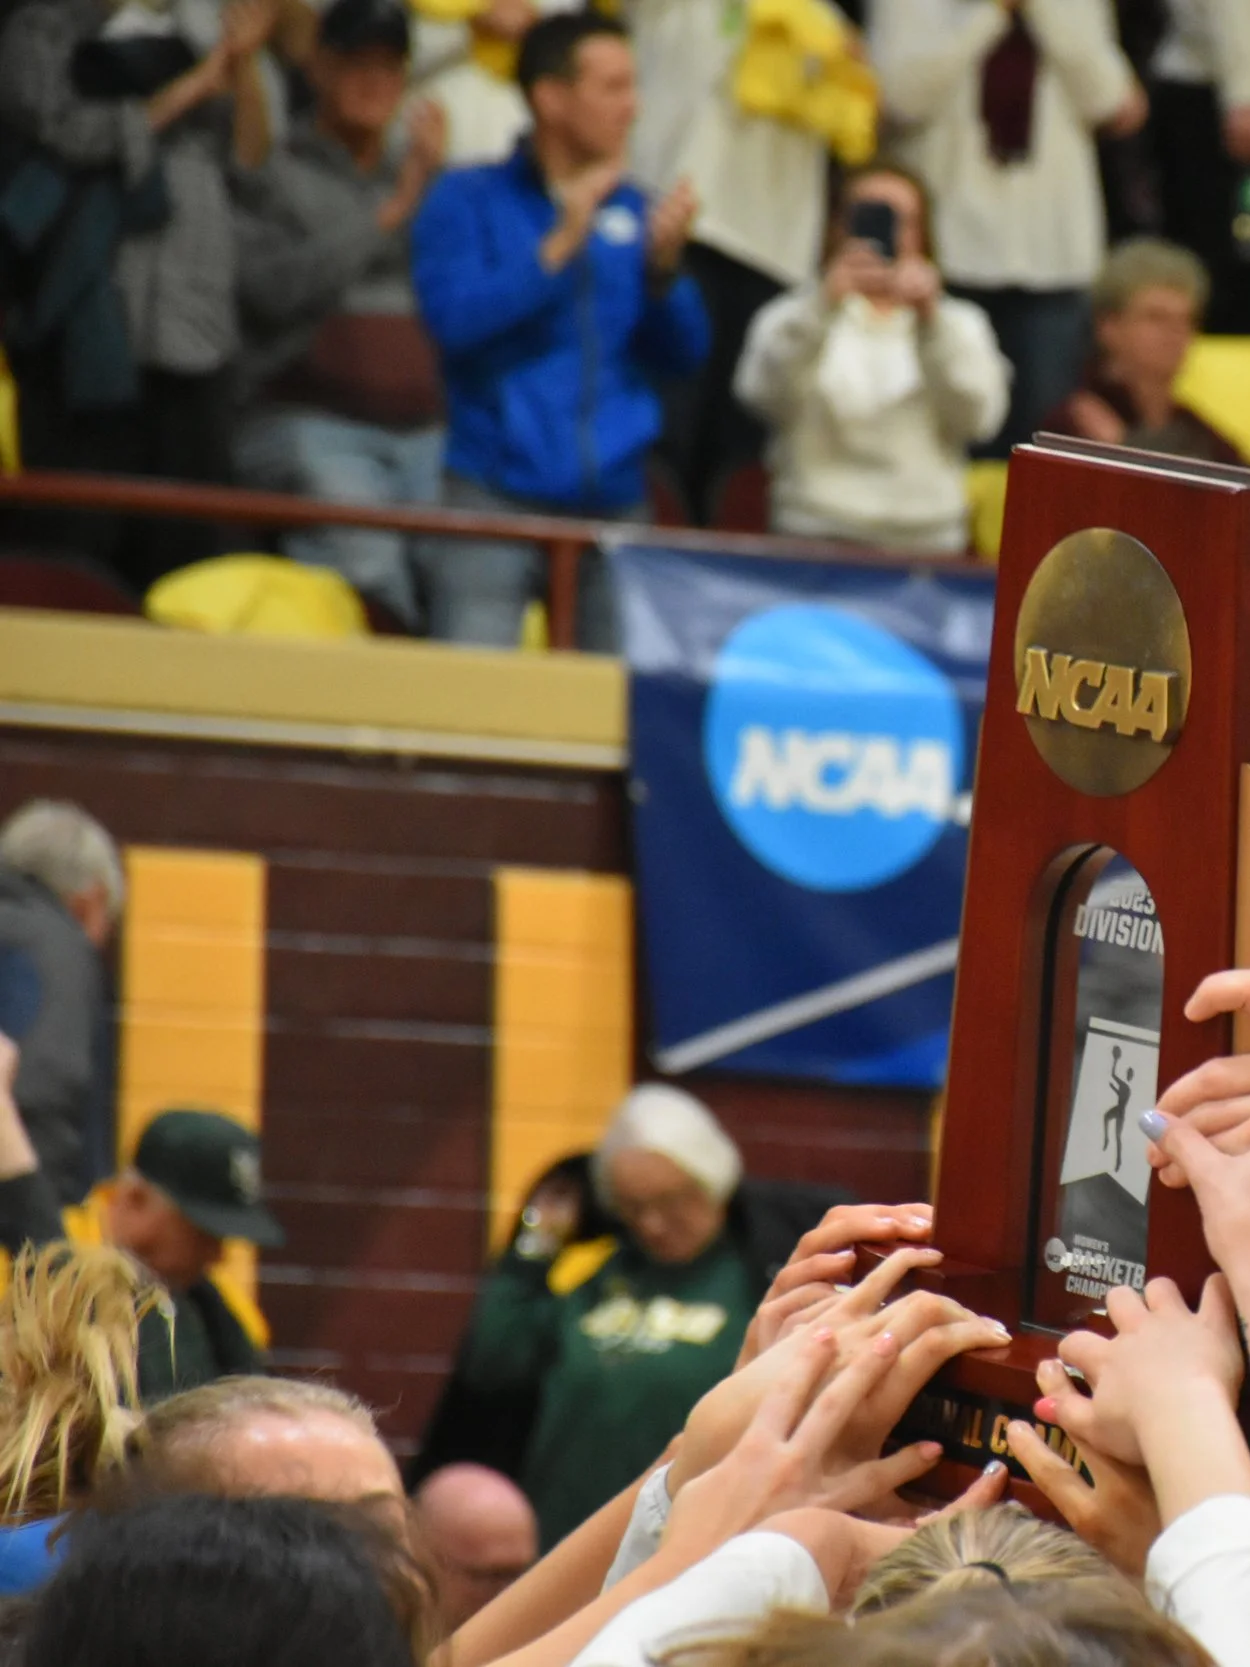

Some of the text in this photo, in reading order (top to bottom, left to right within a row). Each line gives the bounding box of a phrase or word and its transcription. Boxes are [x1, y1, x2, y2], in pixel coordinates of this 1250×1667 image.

[1016, 646, 1178, 743] NCAA
[727, 725, 955, 824] NCAA
[1065, 1274, 1112, 1301] CHAMP
